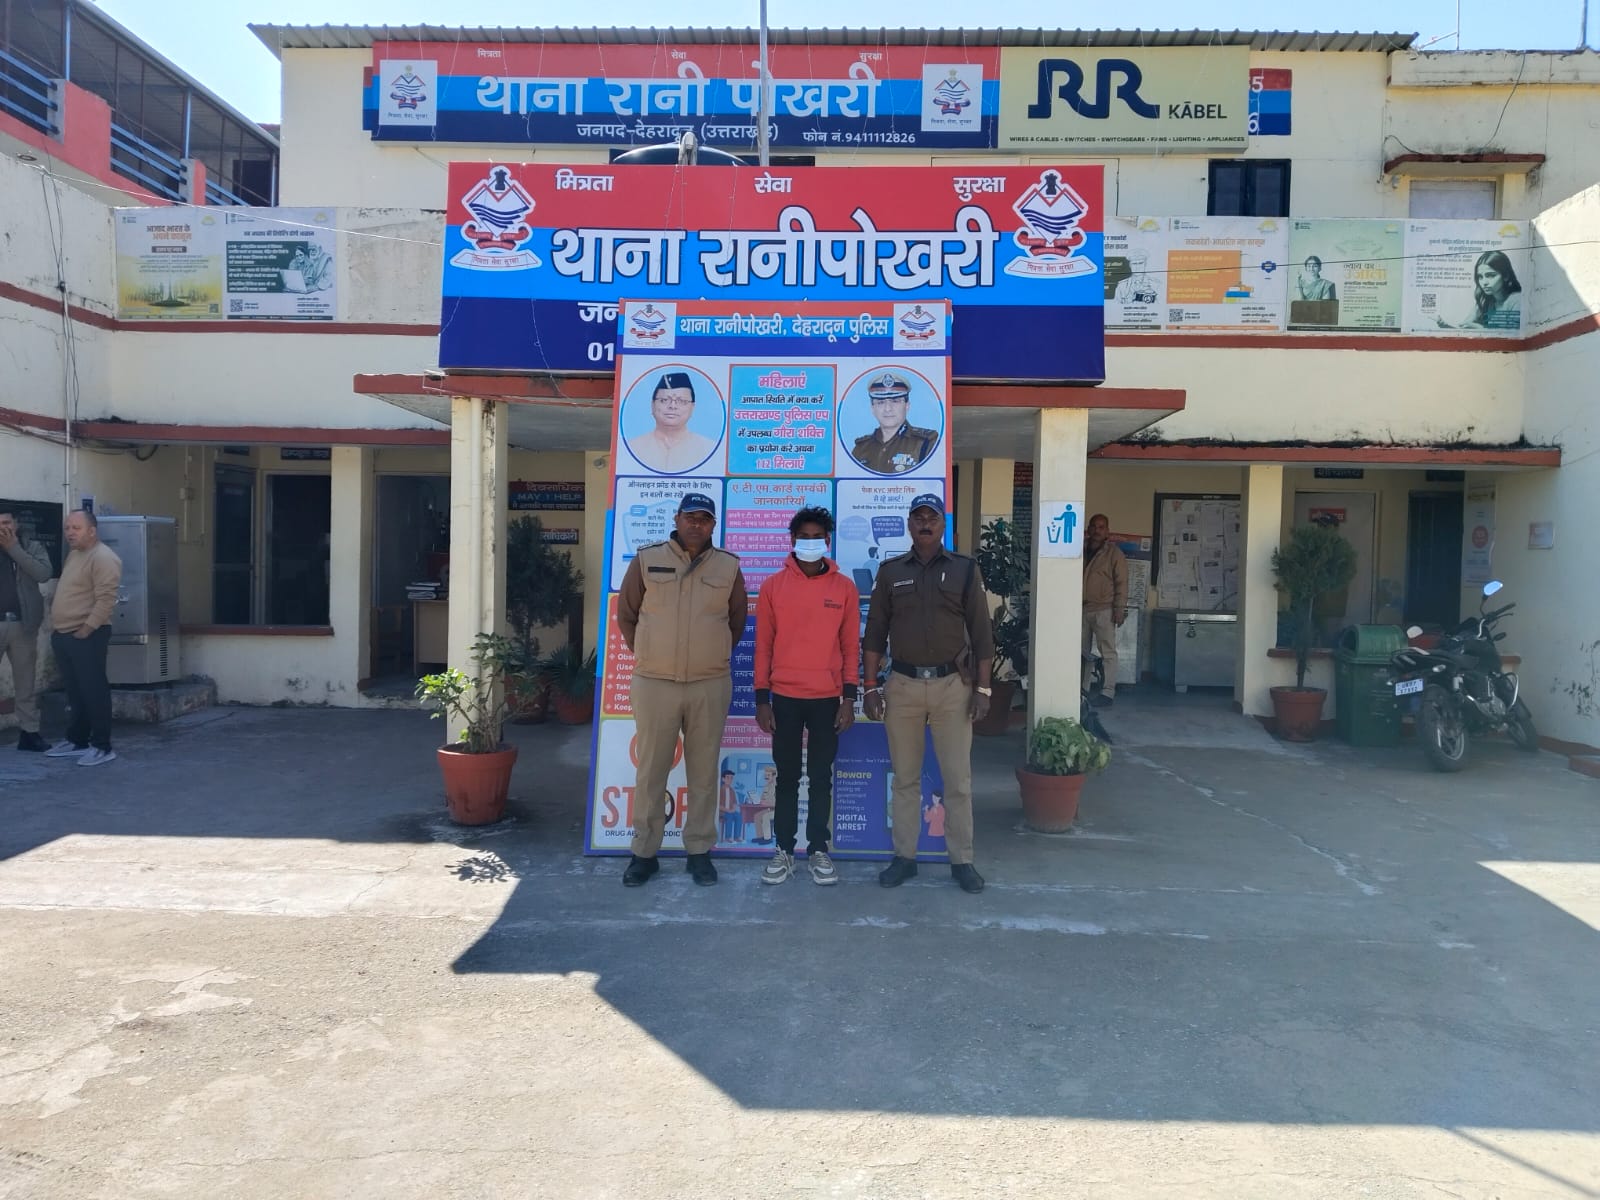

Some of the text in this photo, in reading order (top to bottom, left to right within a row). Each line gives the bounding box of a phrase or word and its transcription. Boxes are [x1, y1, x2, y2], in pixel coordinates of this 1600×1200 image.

[671, 50, 687, 60] सेवा
[859, 51, 883, 62] सुरक्षा
[476, 60, 882, 118] थाना रानी पोखरी
[1028, 58, 1160, 119] RR
[1168, 101, 1228, 119] KĀBEL
[701, 124, 779, 142] (उत्तराखड)
[803, 129, 828, 143] फोन
[555, 168, 615, 192] मित्रता
[754, 171, 792, 194] सेवा
[953, 176, 1007, 201] सुरक्षा
[552, 204, 1000, 290] थाना रानीपोखरी
[680, 317, 710, 334] थाना
[792, 313, 845, 343] देहरादून
[849, 312, 889, 343] पुलिस
[758, 371, 807, 389] महिलाएं
[735, 406, 829, 425] उत्तराखण्ड पुलिस एप
[836, 823, 867, 831] ARREST
